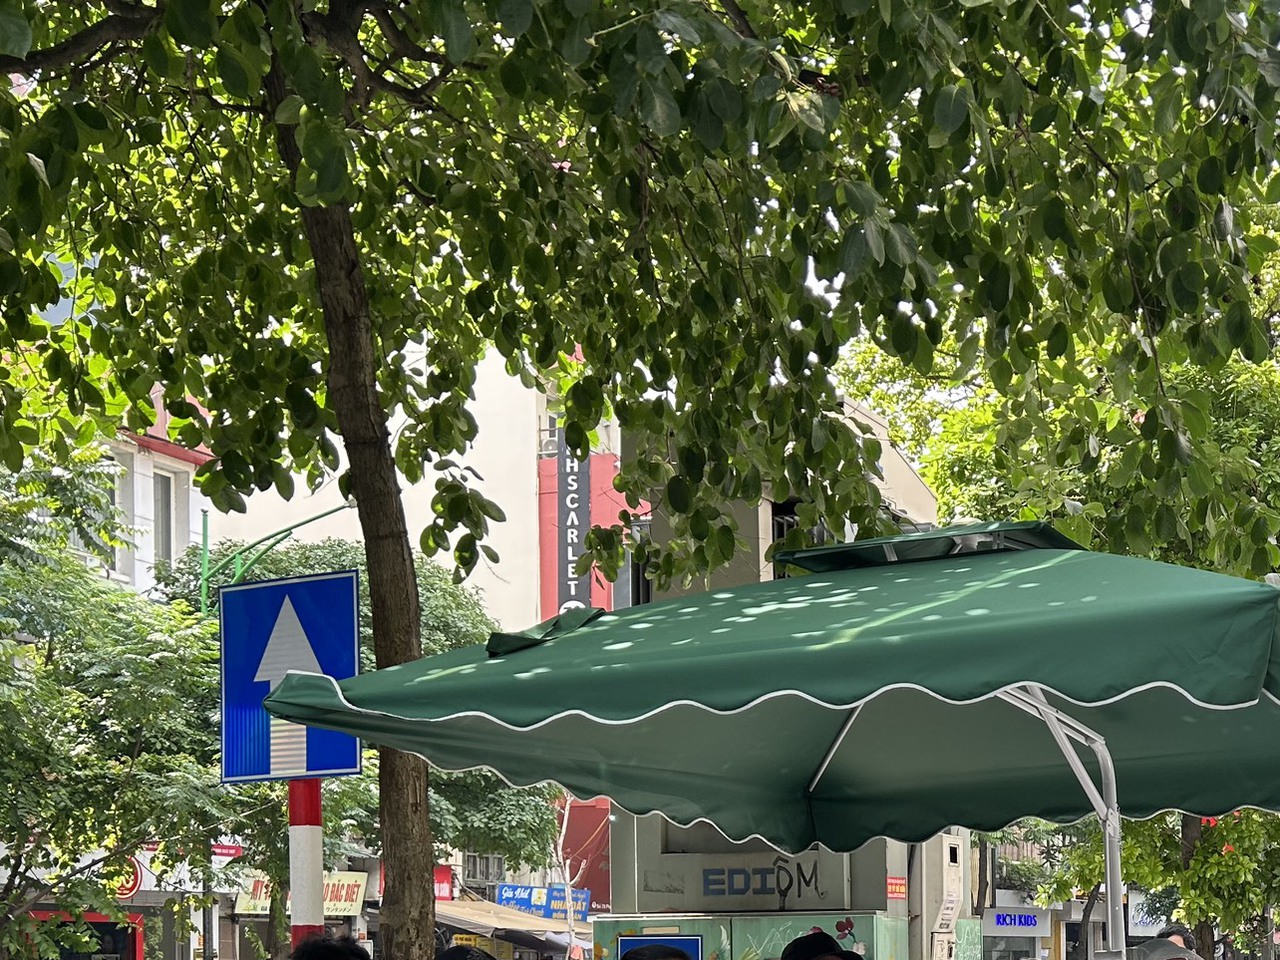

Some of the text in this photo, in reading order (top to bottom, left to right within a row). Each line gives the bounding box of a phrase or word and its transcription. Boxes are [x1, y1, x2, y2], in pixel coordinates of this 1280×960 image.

[565, 445, 579, 595] HSCARLET
[995, 913, 1038, 927] RICH KIDS
